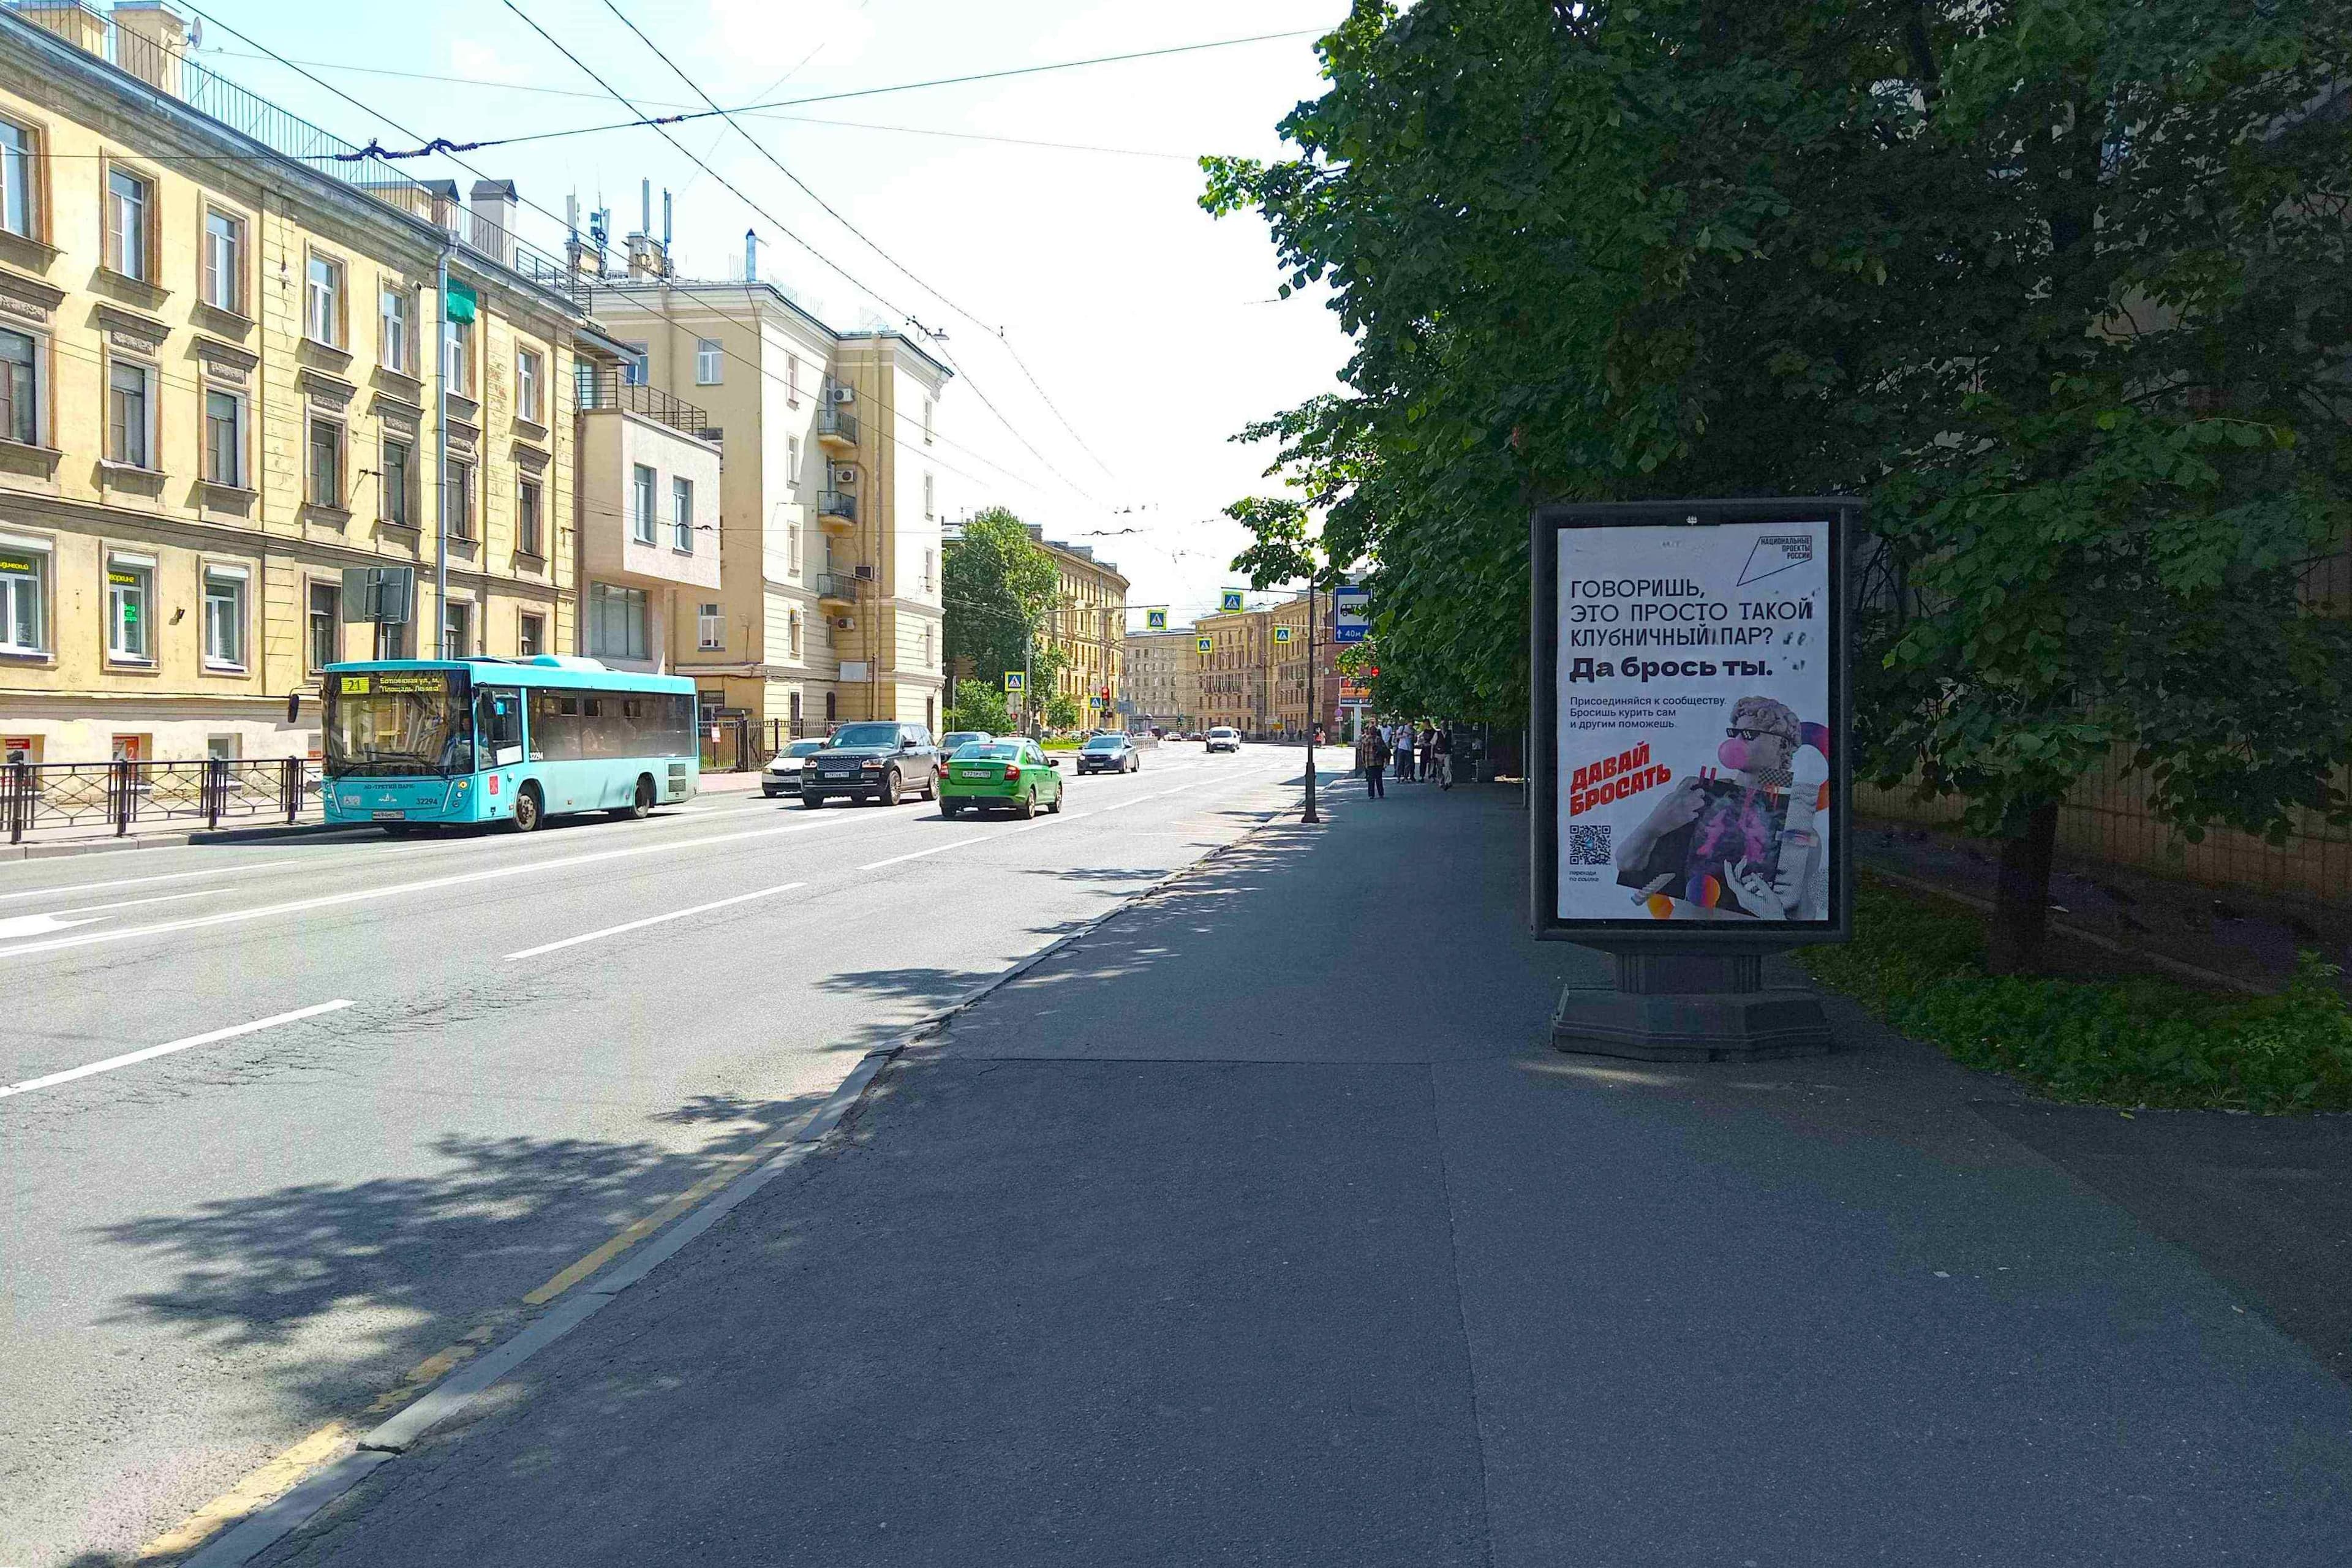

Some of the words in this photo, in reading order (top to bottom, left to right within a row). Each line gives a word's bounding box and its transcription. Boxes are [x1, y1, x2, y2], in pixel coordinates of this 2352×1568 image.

[1571, 579, 1706, 598] ГОВОРИШЬ,
[1570, 604, 1619, 622] ЭТО
[1630, 603, 1728, 622] ПРОСТО
[1739, 598, 1813, 620] ТАКОЙ
[1721, 627, 1774, 645] ПАР?
[1569, 657, 1615, 683] Да
[1621, 656, 1717, 683] брось
[1722, 660, 1773, 676] ты.
[347, 679, 362, 691] 21
[1570, 696, 1651, 707] Присоединяйся
[1662, 696, 1727, 707] сообществу.
[1570, 708, 1616, 718] Бросишь
[1619, 710, 1654, 718] курить
[1579, 720, 1616, 730] другим
[1570, 741, 1649, 794] ДАВАЙ
[1570, 764, 1672, 817] БРОСАТЬ
